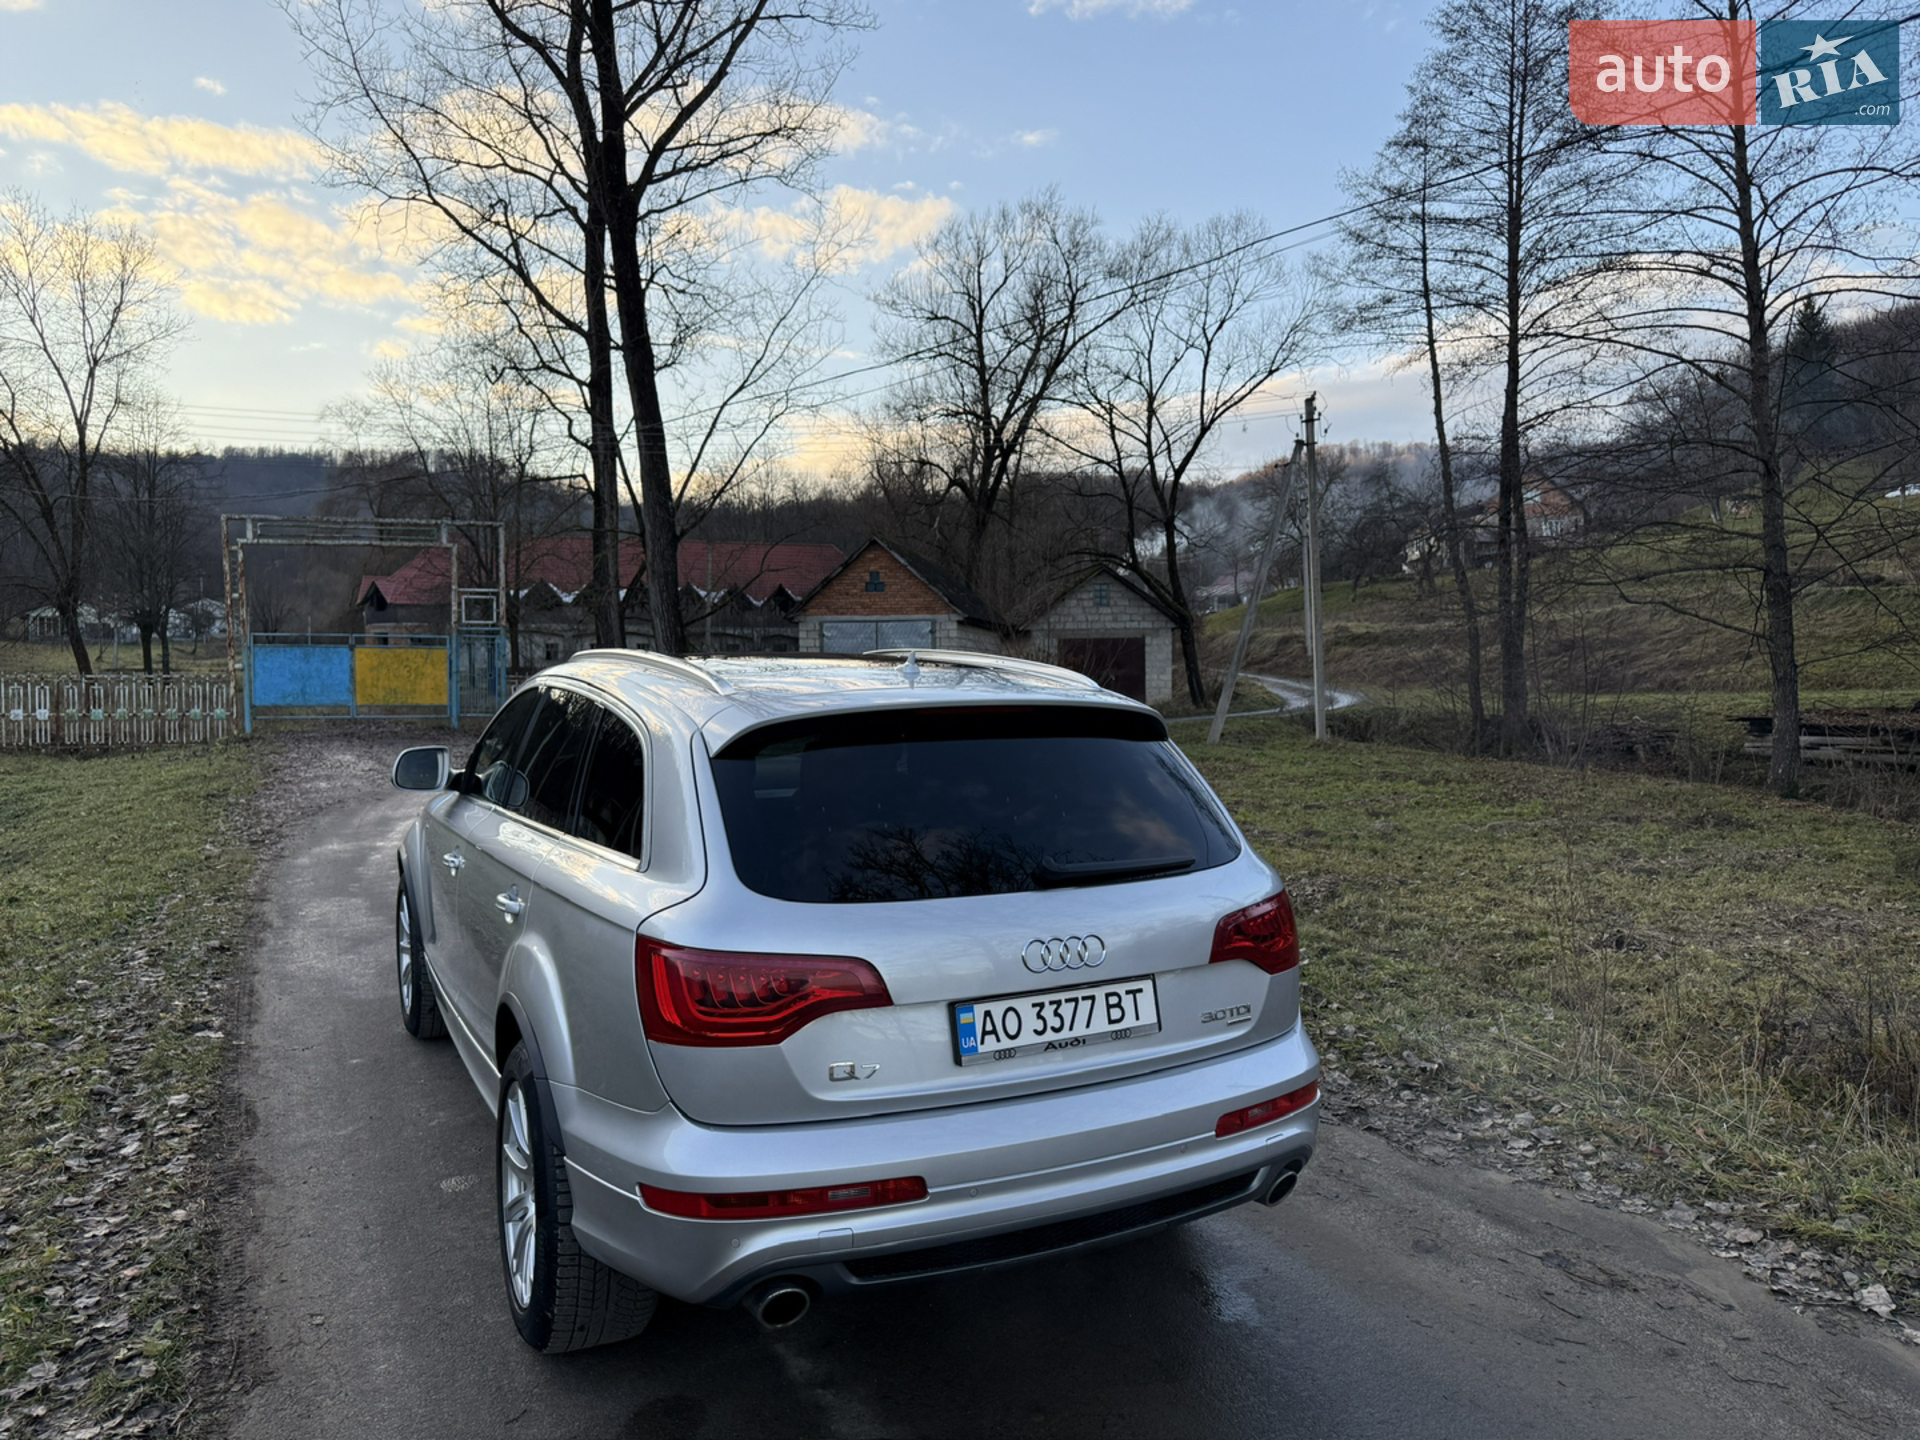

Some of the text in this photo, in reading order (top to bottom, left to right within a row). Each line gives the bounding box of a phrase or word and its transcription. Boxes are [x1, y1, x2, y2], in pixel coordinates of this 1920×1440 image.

[979, 988, 1144, 1046] AO 3377 BT
[961, 1037, 977, 1049] UA
[1043, 1038, 1087, 1052] Audi
[829, 1062, 881, 1082] Q7
